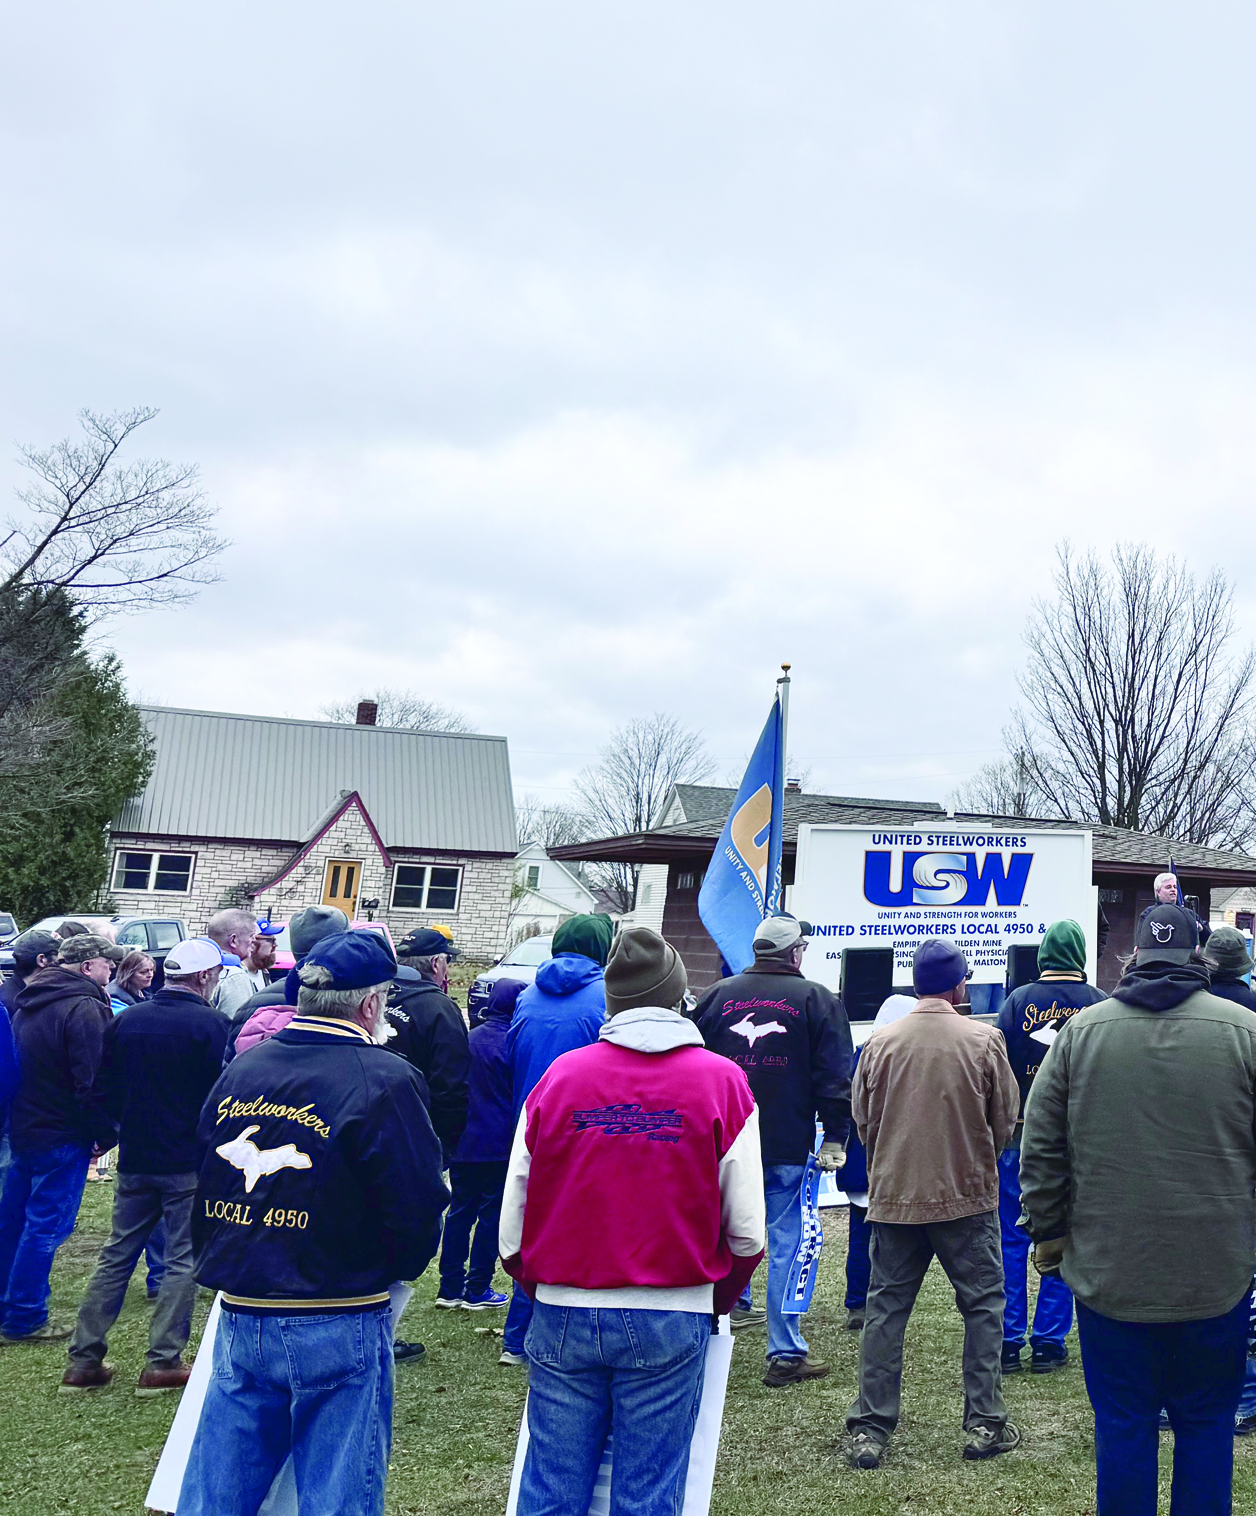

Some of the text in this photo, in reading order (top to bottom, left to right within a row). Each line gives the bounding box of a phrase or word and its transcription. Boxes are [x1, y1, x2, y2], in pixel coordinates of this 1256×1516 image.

[872, 834, 1027, 847] UNITED STEELWORKERS
[724, 845, 743, 871] UNITY
[740, 871, 755, 892] AND
[863, 850, 1035, 909] USW
[877, 911, 1017, 919] UNITY AND STRENGTH FOR WORKERS
[859, 924, 956, 936] STEELWORKERS
[961, 923, 1000, 934] LOCAL
[1004, 923, 1034, 934] 4950
[826, 952, 842, 960] EAS
[216, 1095, 331, 1138] Steelworkers
[573, 1113, 683, 1125] BUMPER TO BUMPER
[647, 1132, 681, 1144] Racing
[205, 1200, 309, 1229] LOCAL 4950
